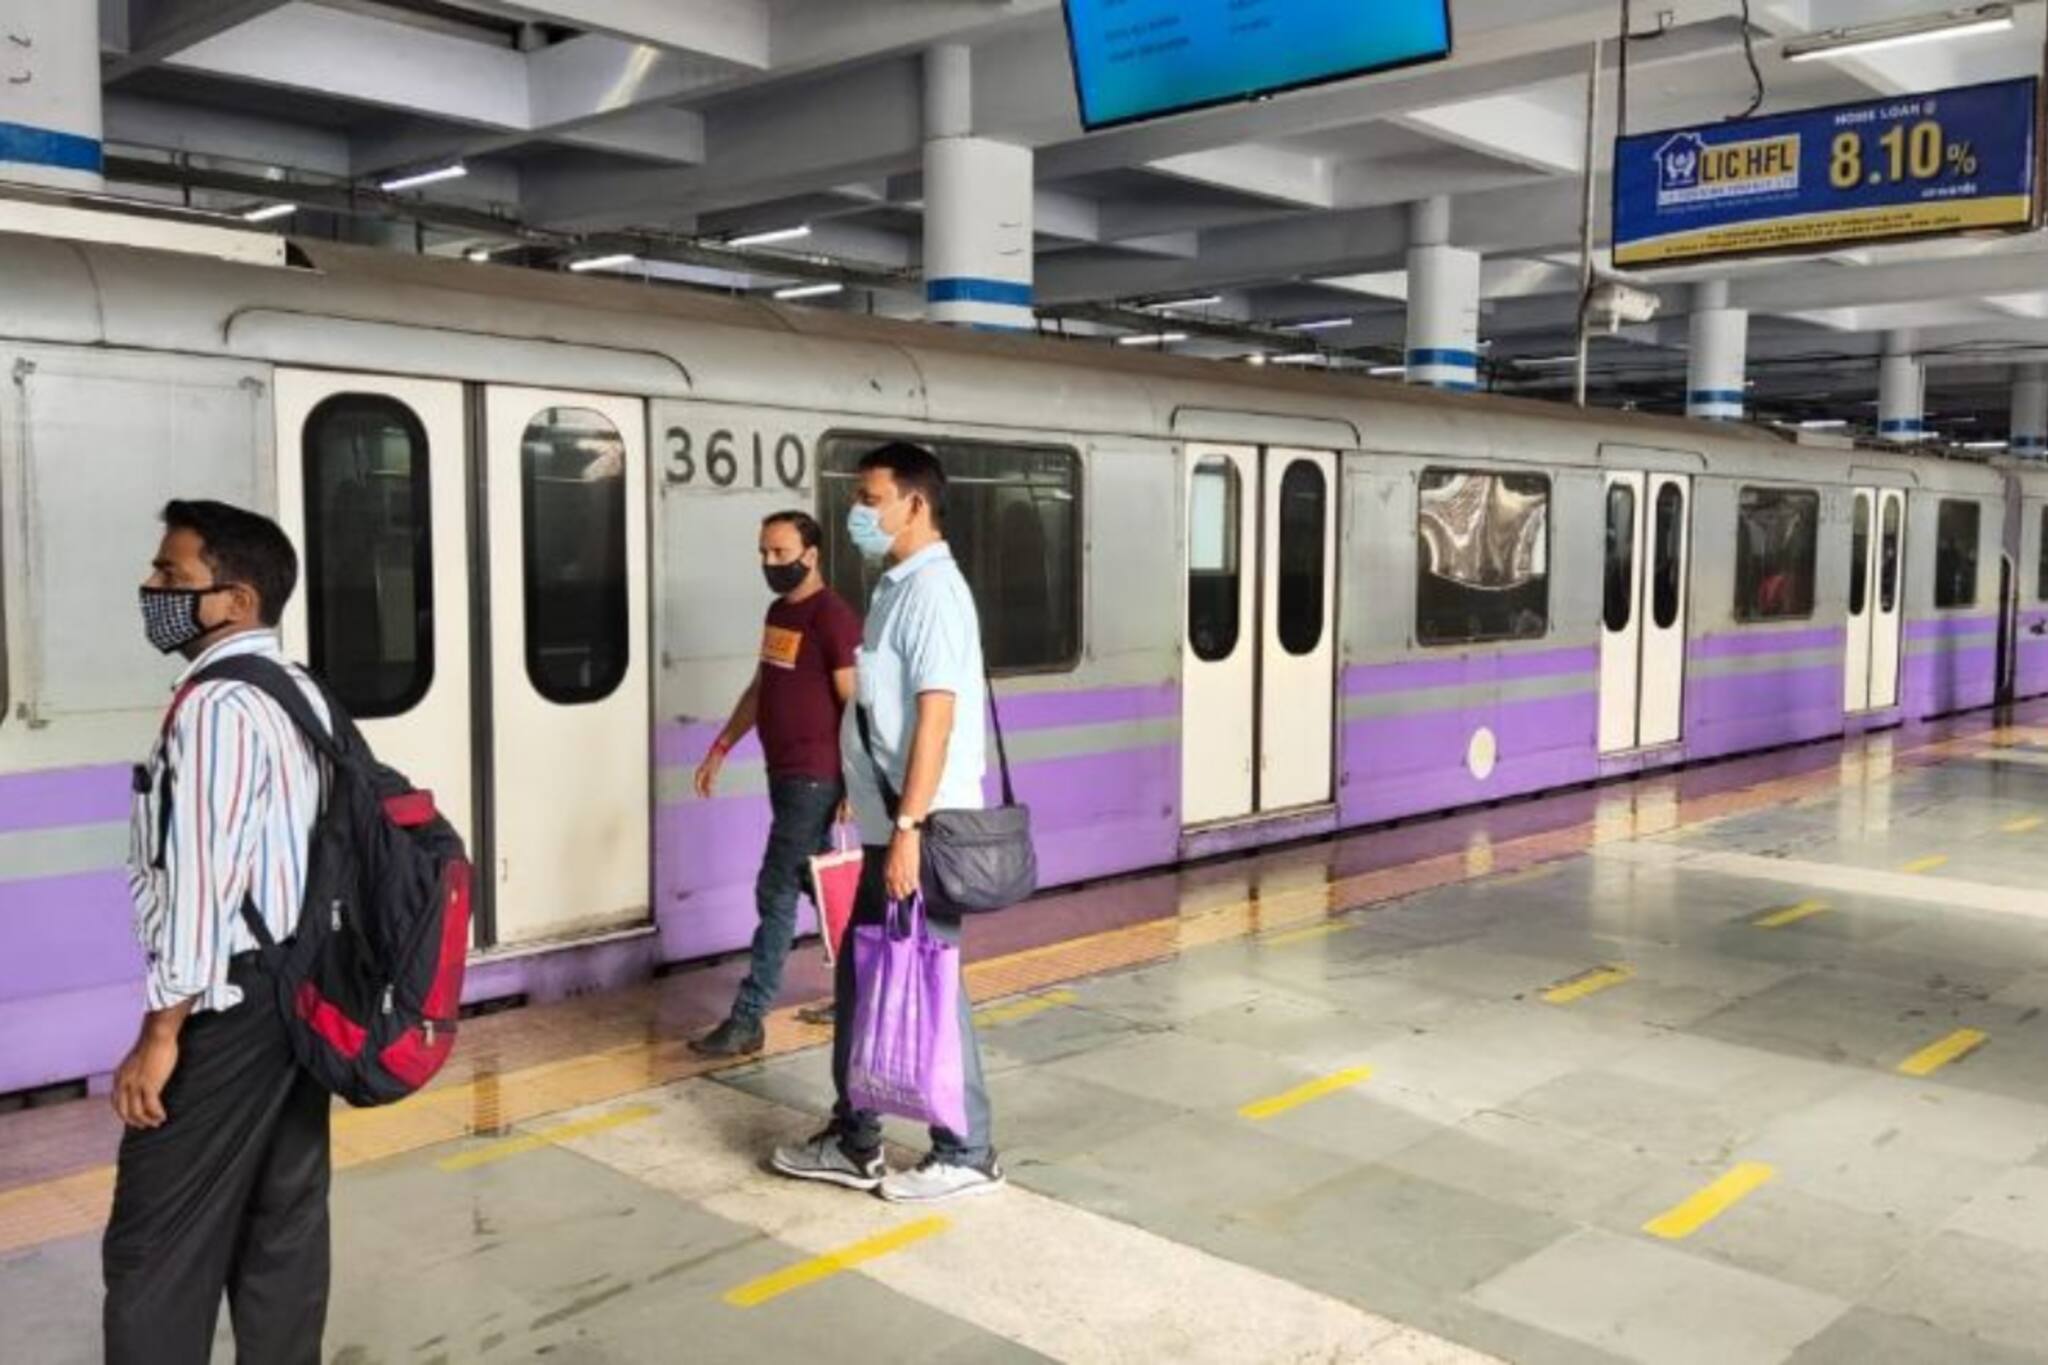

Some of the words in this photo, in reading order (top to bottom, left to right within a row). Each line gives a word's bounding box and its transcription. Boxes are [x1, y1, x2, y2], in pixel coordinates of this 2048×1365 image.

[1834, 110, 1875, 125] HOME
[1880, 103, 1920, 120] LOAN
[1702, 150, 1740, 181] LIC
[1746, 143, 1793, 176] HFL
[665, 426, 806, 488] 3610
